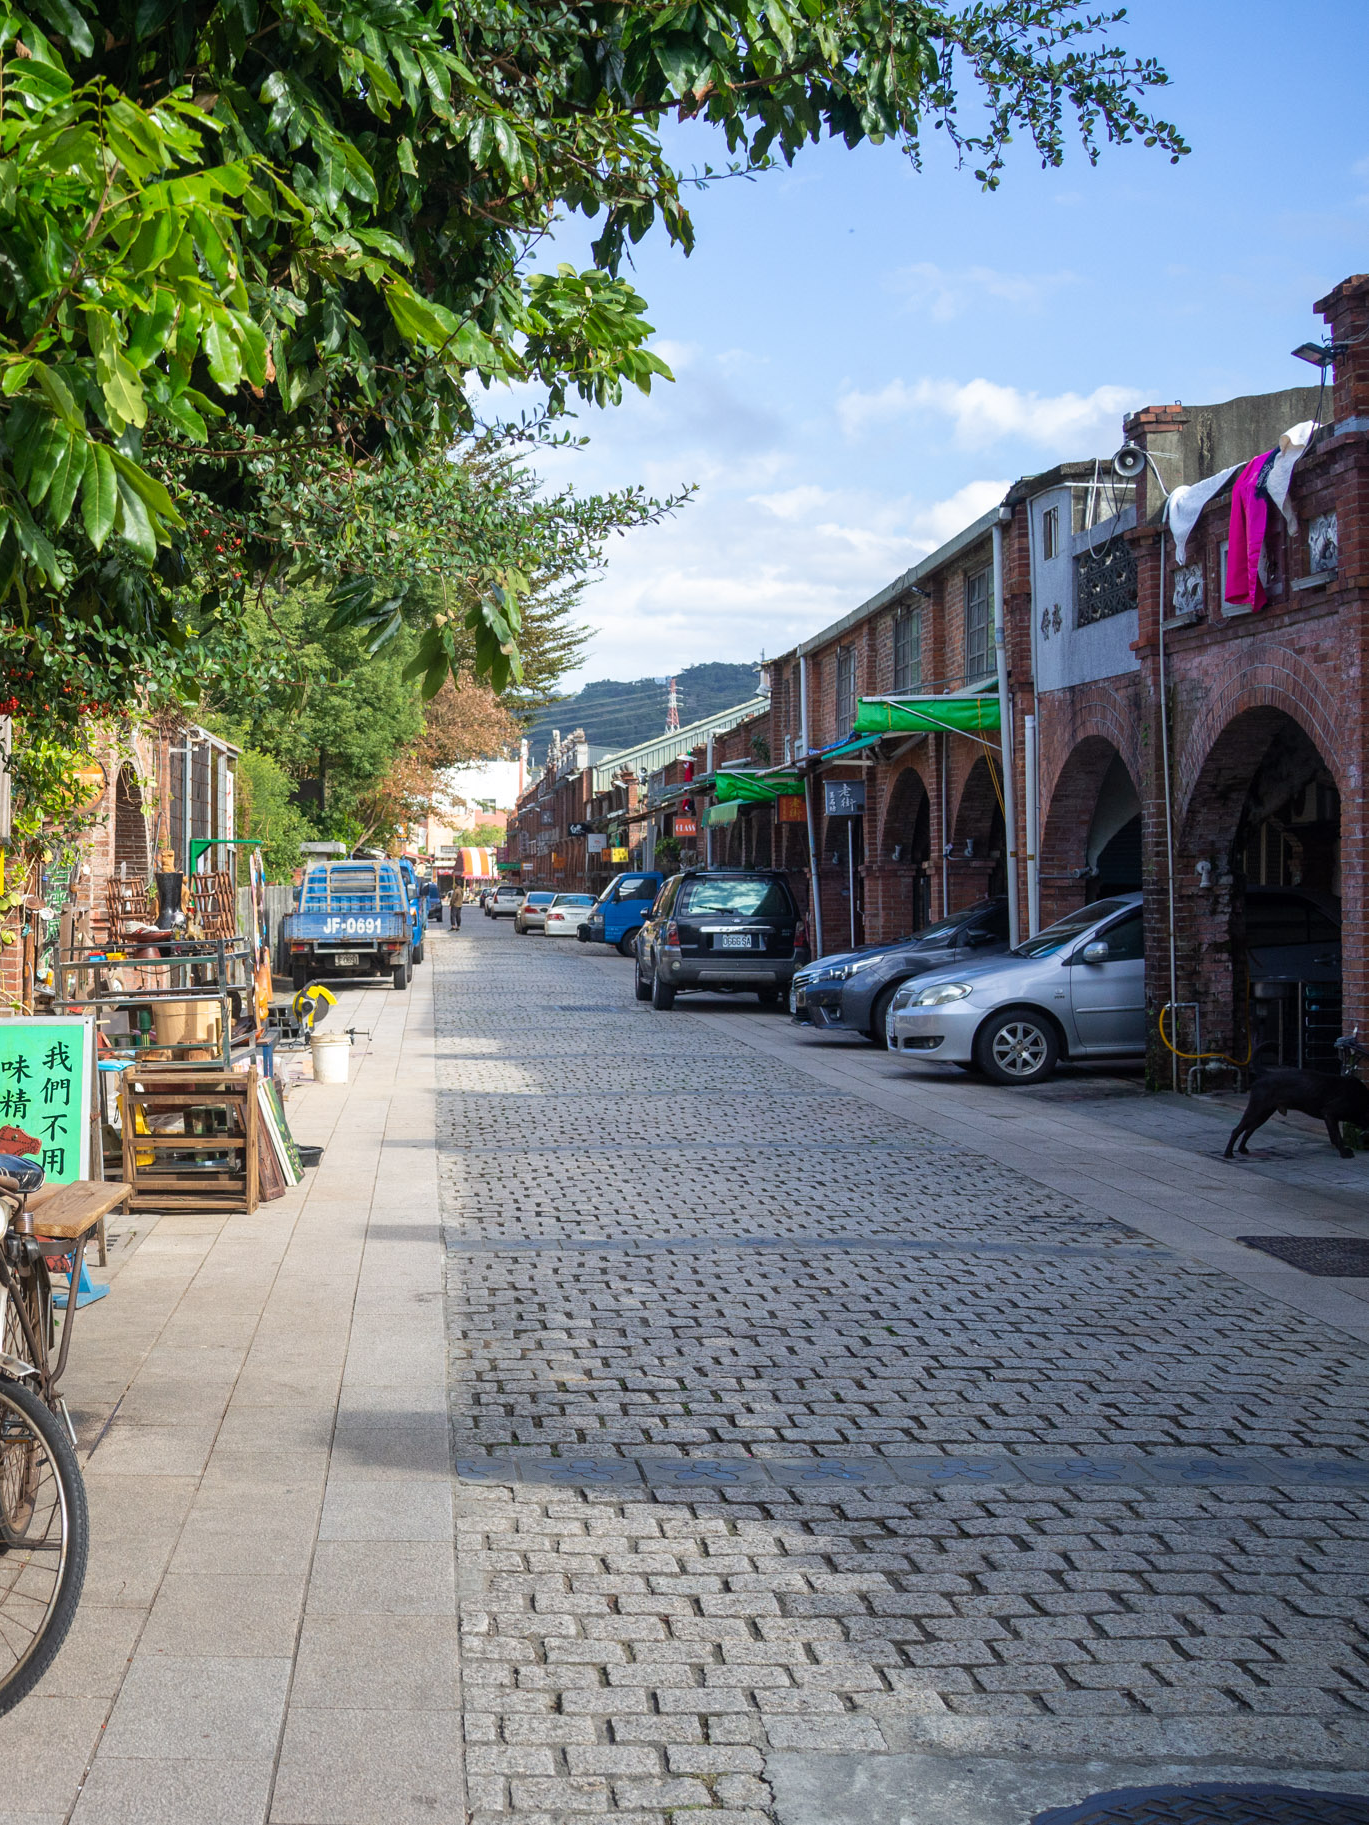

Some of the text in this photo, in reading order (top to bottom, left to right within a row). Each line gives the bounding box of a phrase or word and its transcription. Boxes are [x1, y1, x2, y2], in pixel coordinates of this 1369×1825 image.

[837, 783, 857, 812] 老街
[675, 824, 696, 832] GLASS
[323, 917, 382, 934] JF-0691
[40, 1041, 72, 1176] 我們不用
